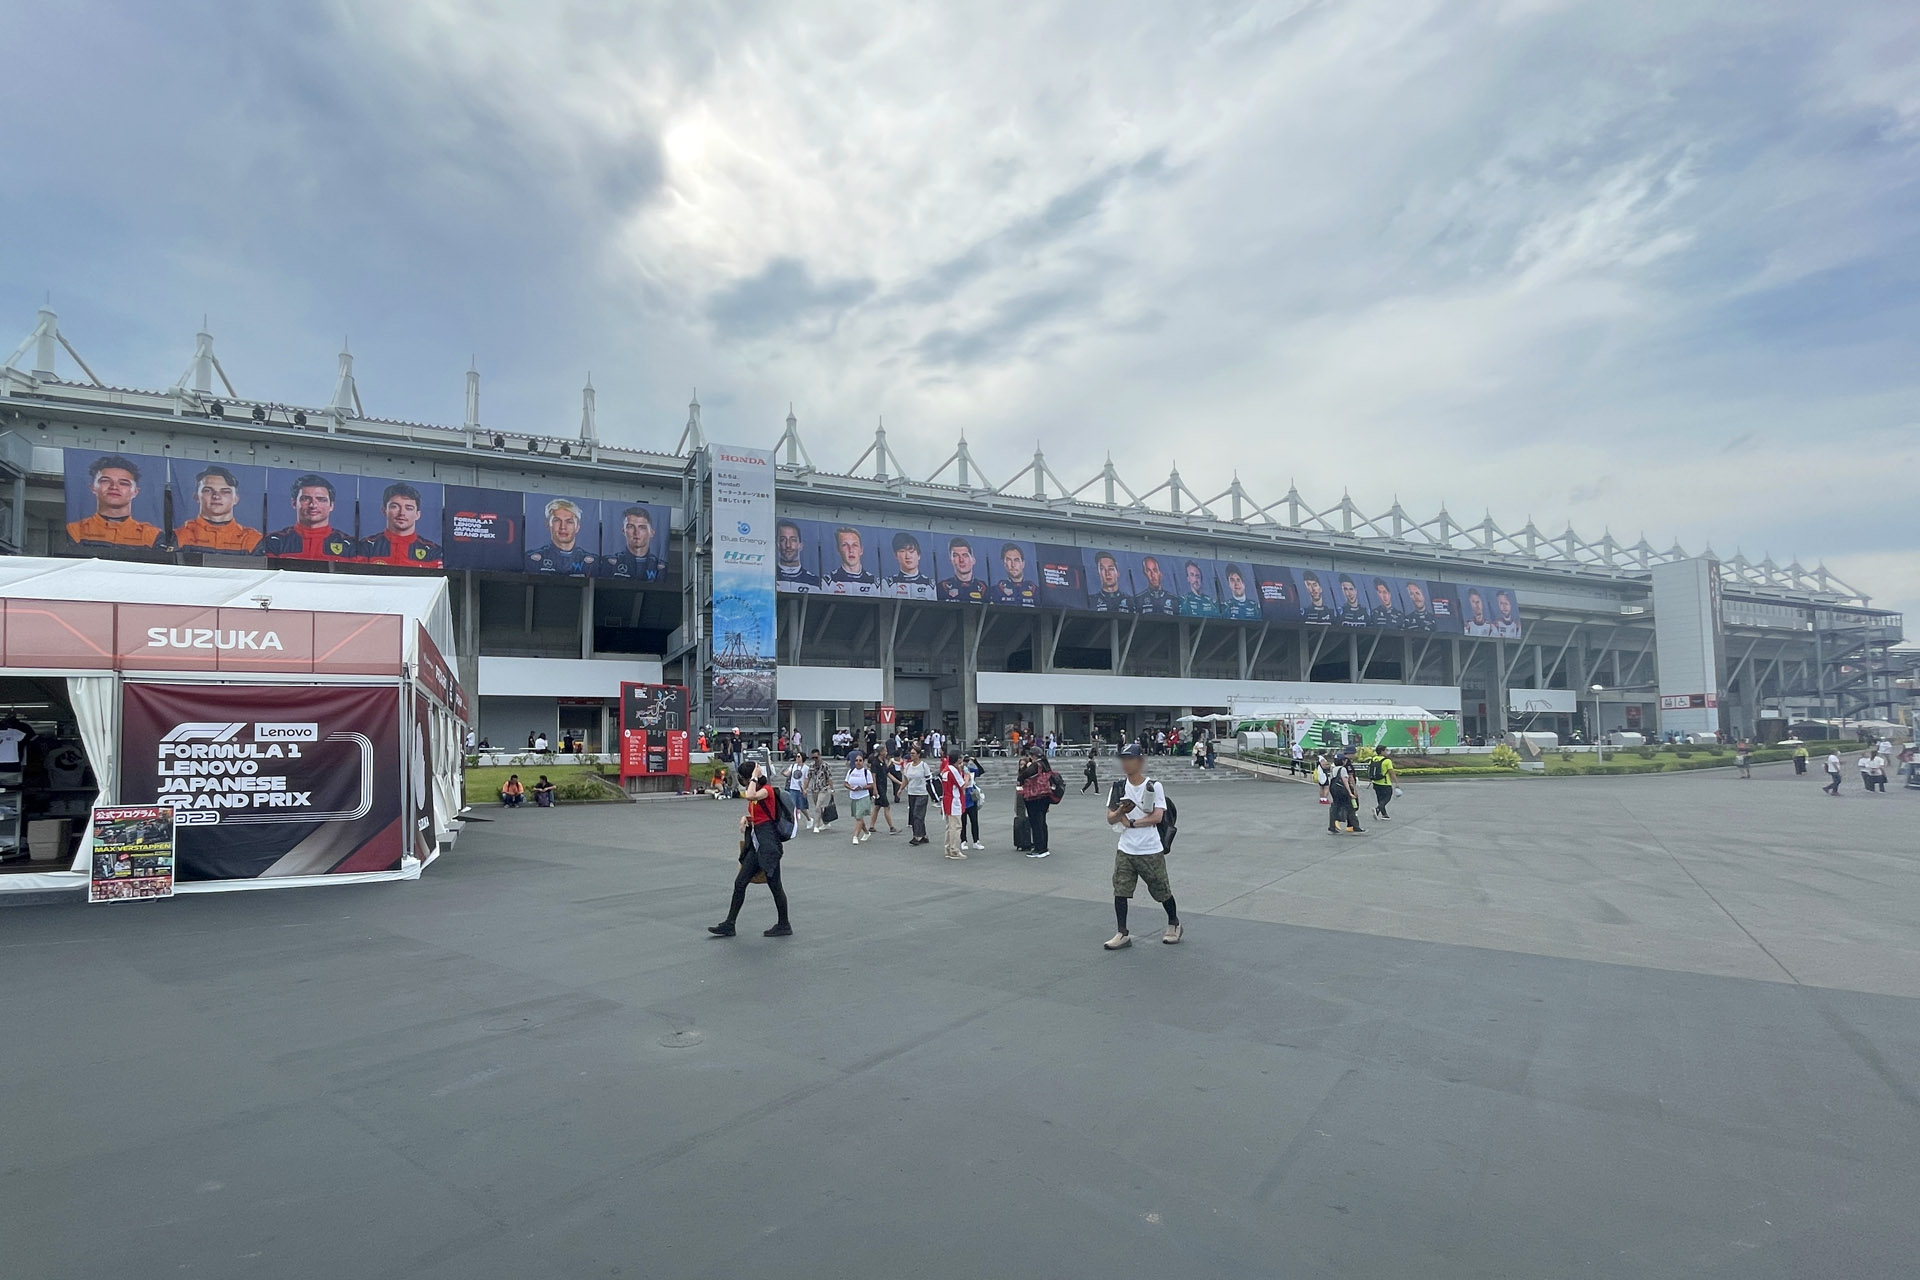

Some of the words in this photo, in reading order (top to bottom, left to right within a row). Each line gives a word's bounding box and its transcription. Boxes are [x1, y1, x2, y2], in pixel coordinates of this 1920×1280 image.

[720, 455, 767, 465] HONDA
[721, 535, 738, 543] Blue
[739, 537, 767, 546] Energy
[147, 627, 284, 651] SUZUKA
[883, 710, 893, 722] V
[260, 727, 313, 737] Lenovo
[158, 743, 284, 759] FORMULA
[288, 743, 302, 758] 1
[157, 760, 259, 776] LENOVO
[157, 776, 287, 793] JAPANESE
[157, 794, 250, 809] GRAND
[253, 791, 312, 808] PRIX
[96, 810, 157, 820] 公式プログラム
[117, 842, 171, 852] VERSTAPPEN
